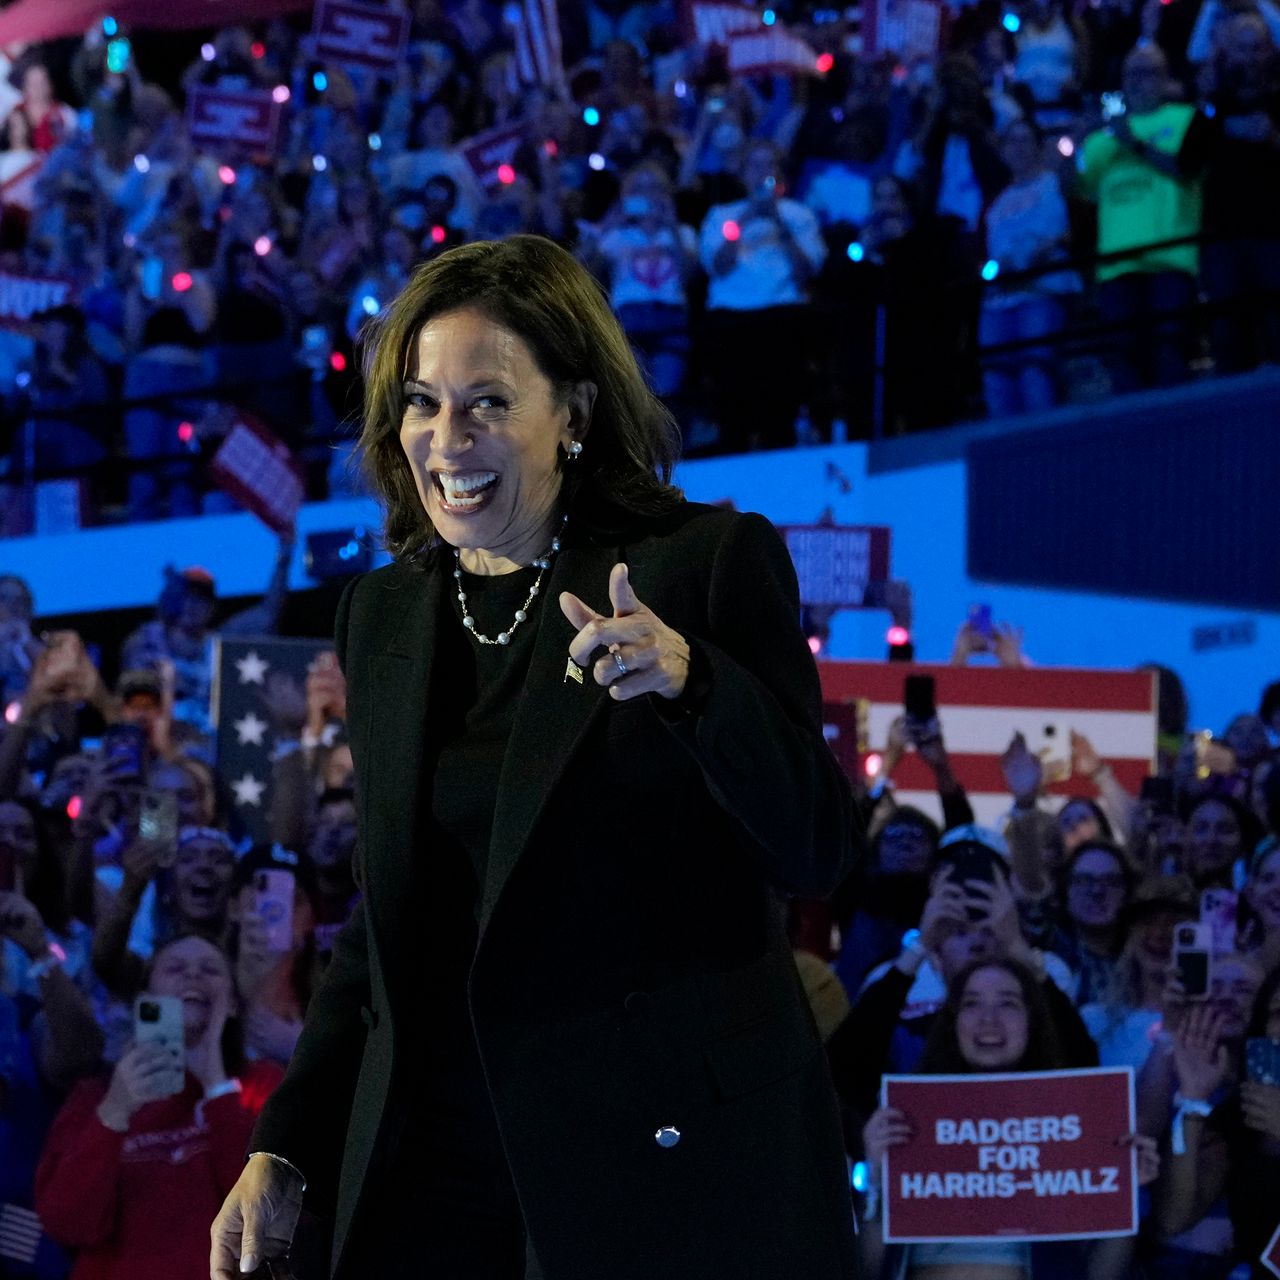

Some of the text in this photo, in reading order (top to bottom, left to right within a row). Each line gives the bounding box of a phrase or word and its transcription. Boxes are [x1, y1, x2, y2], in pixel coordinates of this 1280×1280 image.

[935, 1114, 1082, 1145] BADGERS
[977, 1145, 1040, 1171] FOR
[900, 1166, 1119, 1200] HARRIS-WALZ
